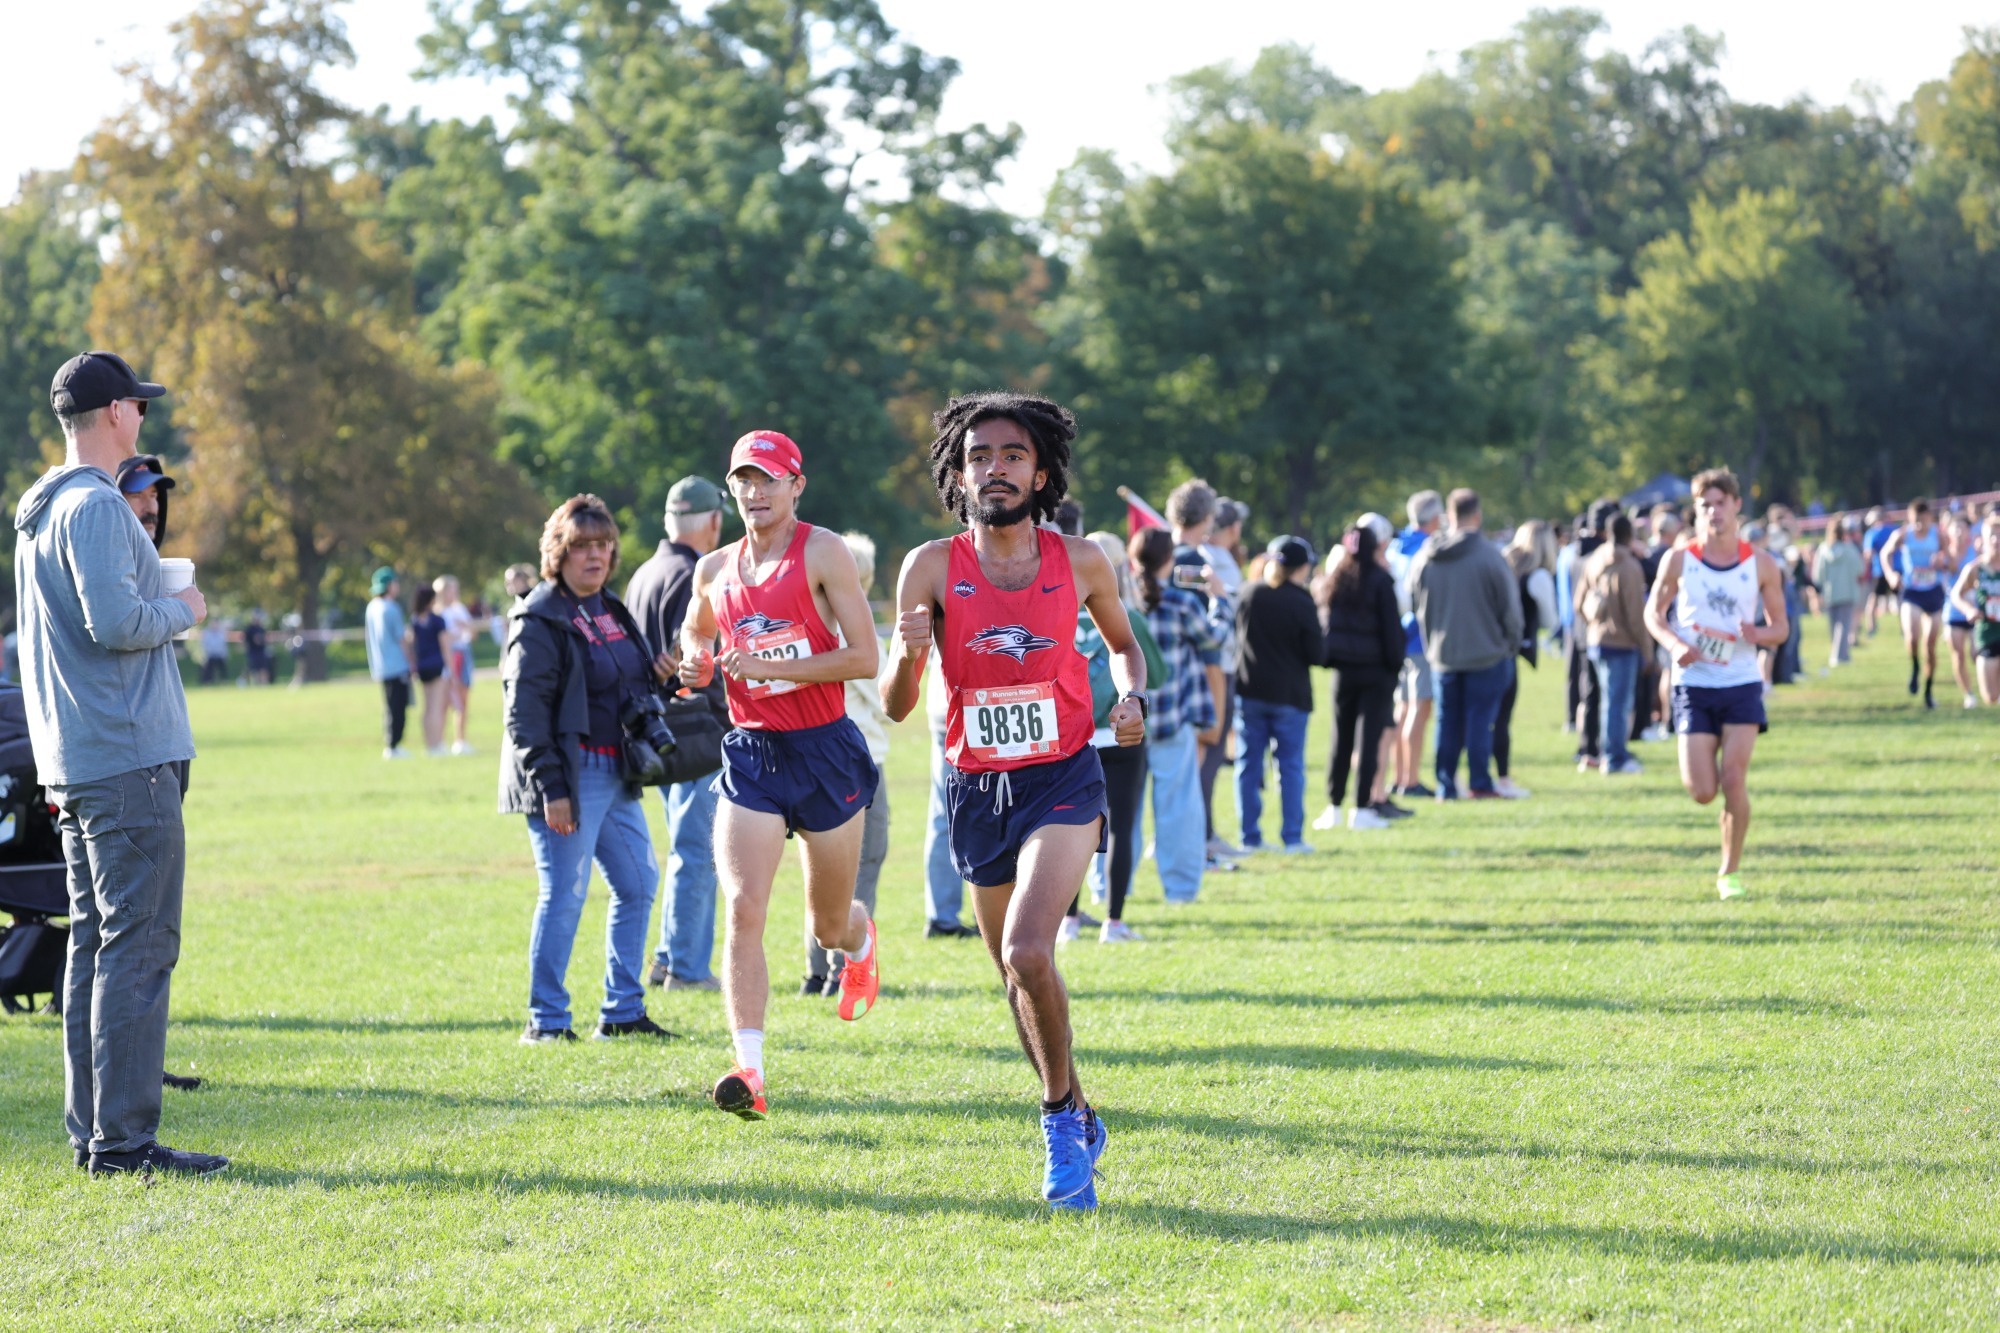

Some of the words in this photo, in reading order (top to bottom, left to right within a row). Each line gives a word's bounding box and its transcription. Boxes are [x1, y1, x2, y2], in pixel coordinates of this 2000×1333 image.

[955, 585, 975, 593] RMAC
[1019, 689, 1037, 697] Roost
[979, 703, 1043, 746] 9836
